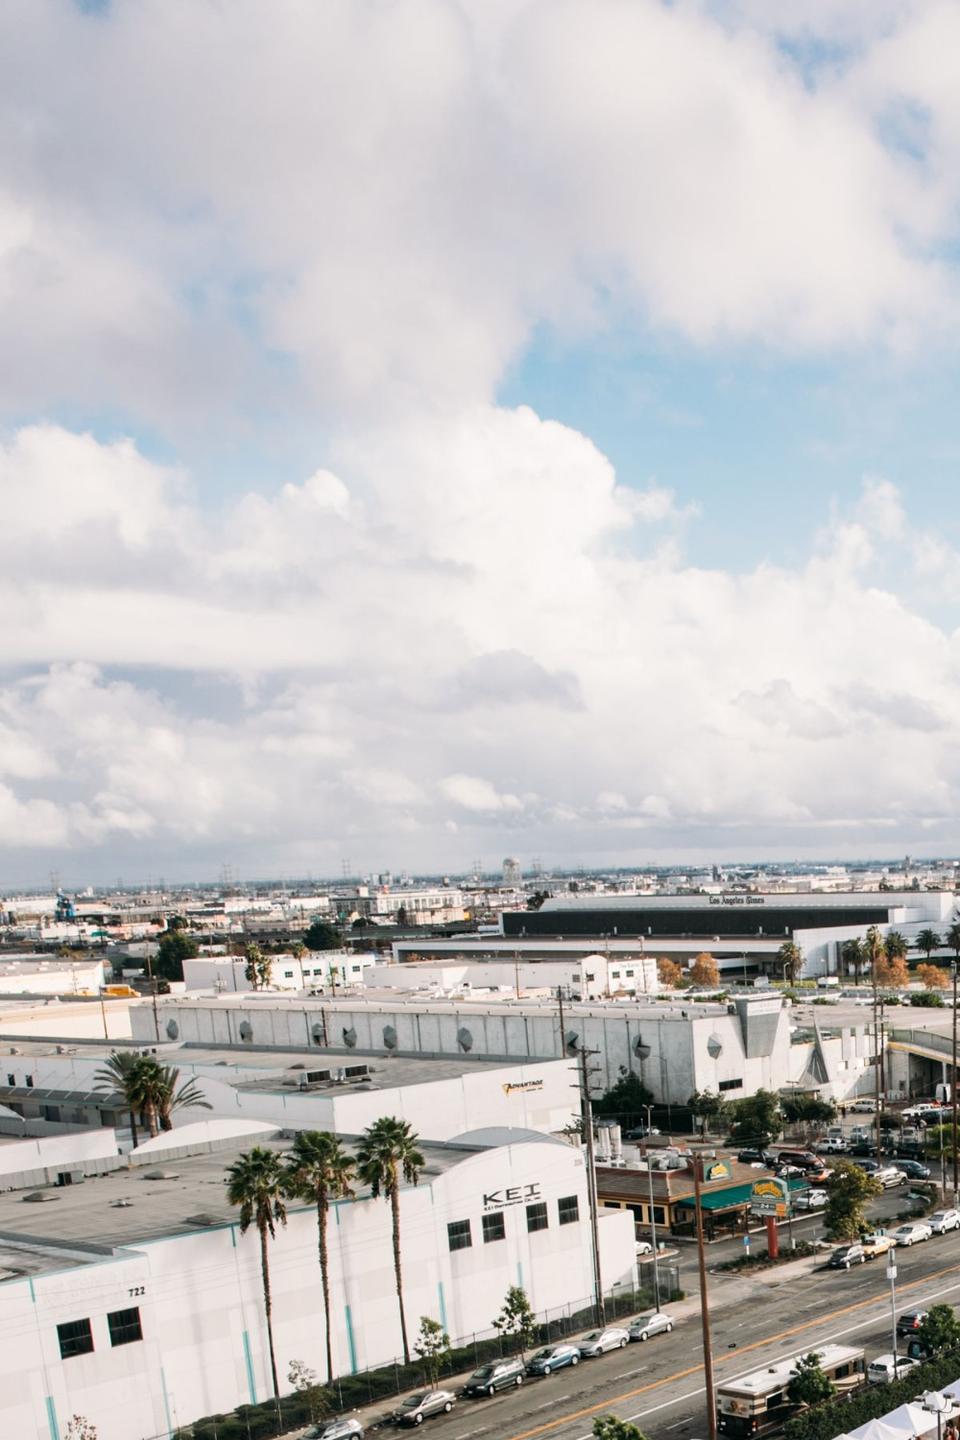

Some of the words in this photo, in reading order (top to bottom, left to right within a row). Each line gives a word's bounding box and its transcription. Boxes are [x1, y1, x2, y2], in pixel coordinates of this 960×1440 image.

[709, 895, 720, 905] Los
[721, 895, 745, 906] Angeles
[483, 1182, 541, 1206] KEI
[128, 1286, 146, 1297] 722
